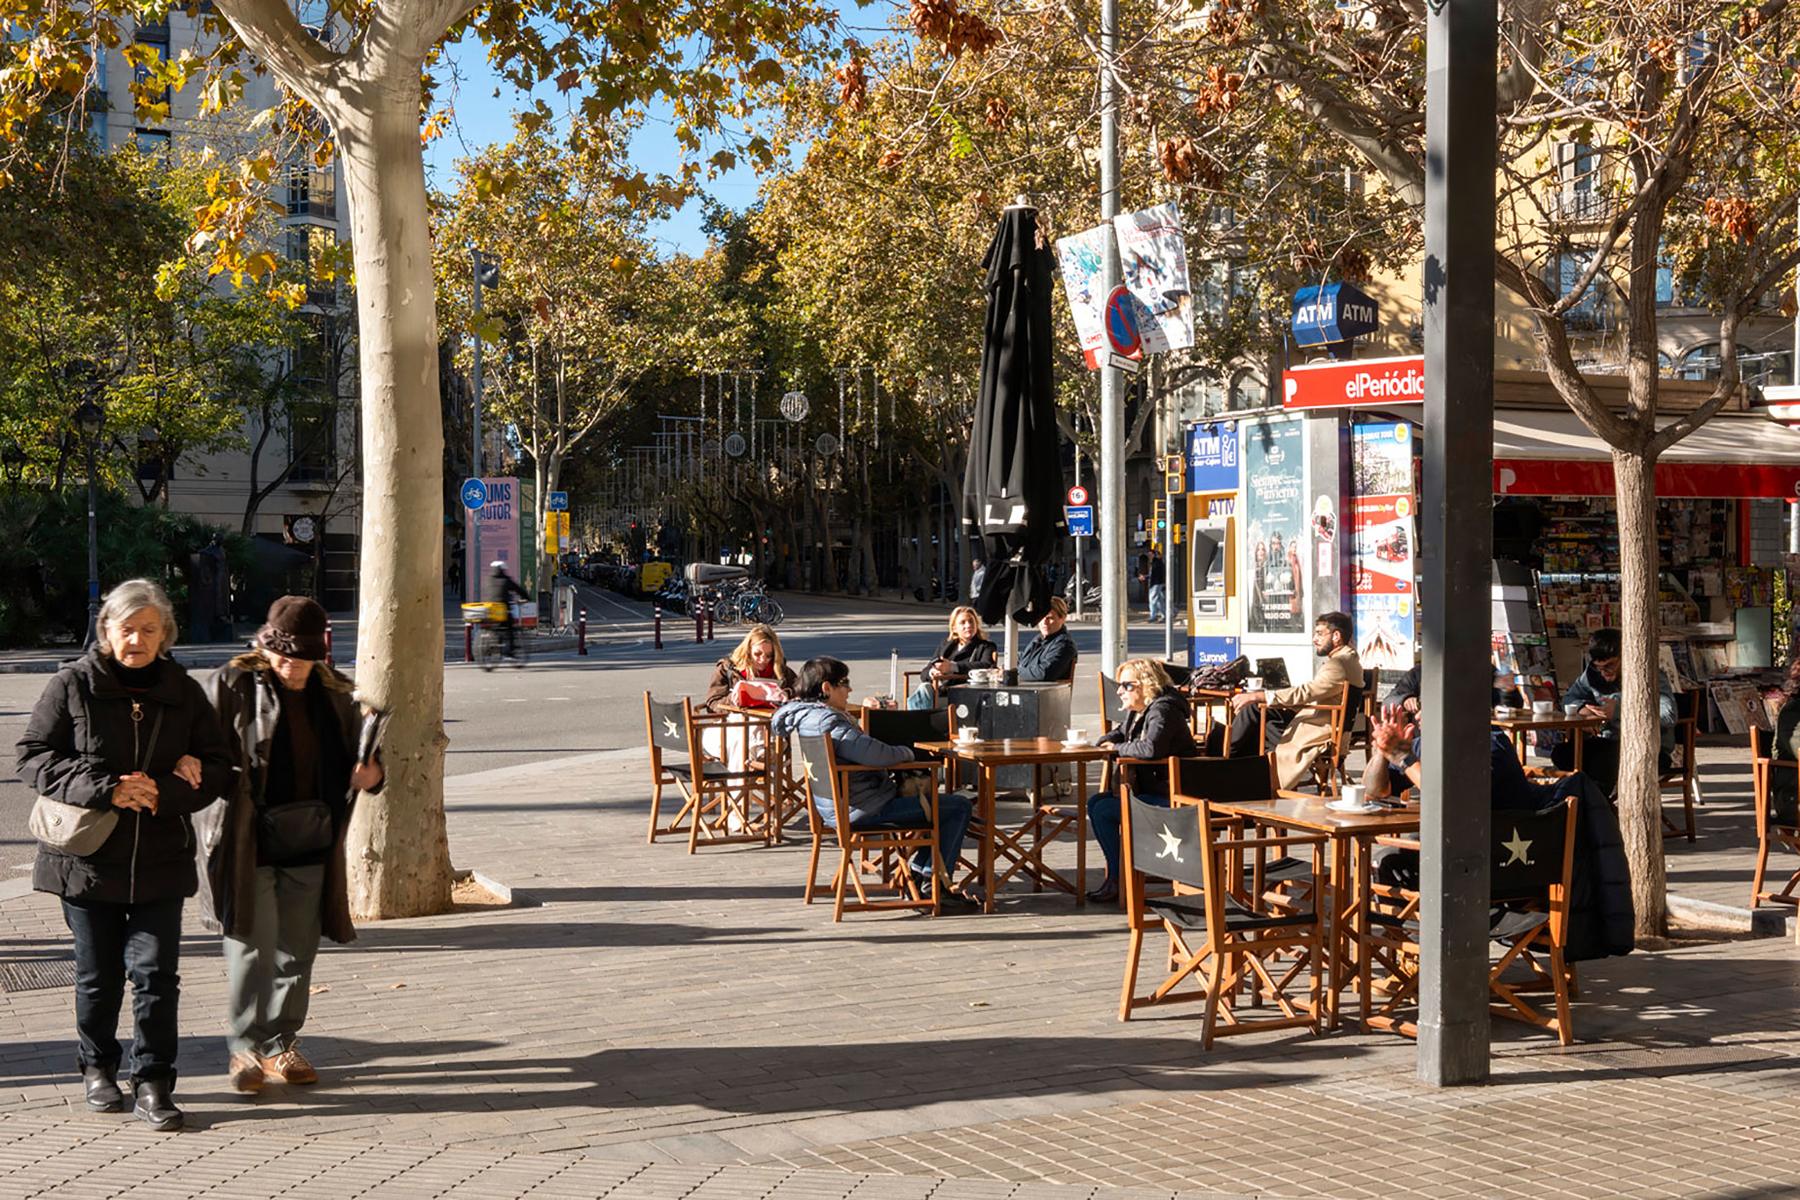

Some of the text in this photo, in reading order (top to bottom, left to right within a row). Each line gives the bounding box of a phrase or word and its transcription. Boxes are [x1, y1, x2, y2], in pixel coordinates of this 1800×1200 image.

[1296, 302, 1333, 324] ATM
[1342, 303, 1373, 323] ATM
[1285, 378, 1298, 402] P
[1345, 369, 1424, 399] elPeriódic
[1191, 436, 1220, 456] ATM
[1499, 468, 1517, 493] P
[485, 483, 511, 503] UMS
